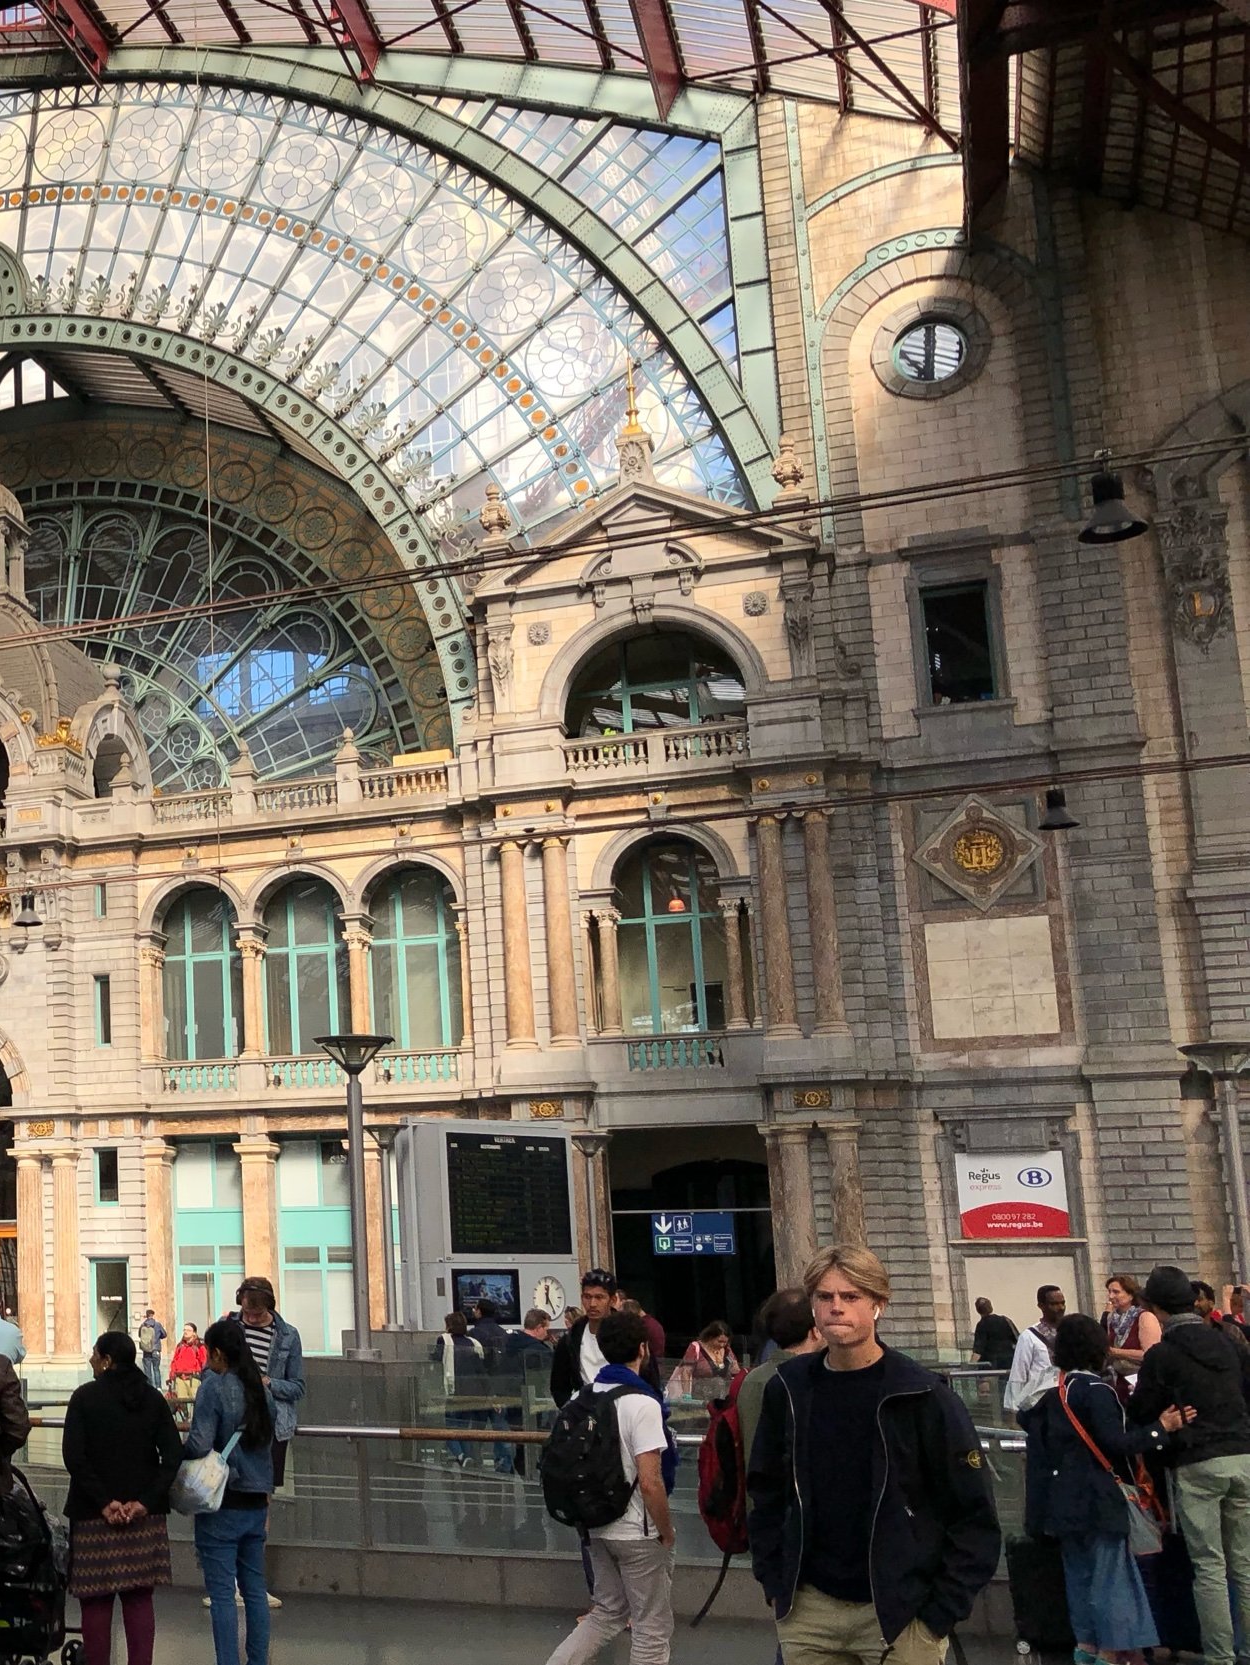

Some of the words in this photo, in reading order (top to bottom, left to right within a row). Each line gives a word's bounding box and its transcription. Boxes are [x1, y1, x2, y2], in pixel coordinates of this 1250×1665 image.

[968, 1170, 1001, 1184] Regus
[1026, 1170, 1044, 1185] B
[969, 1184, 1002, 1192] express
[991, 1213, 1011, 1221] 0800
[986, 1221, 1044, 1230] www.regus.be
